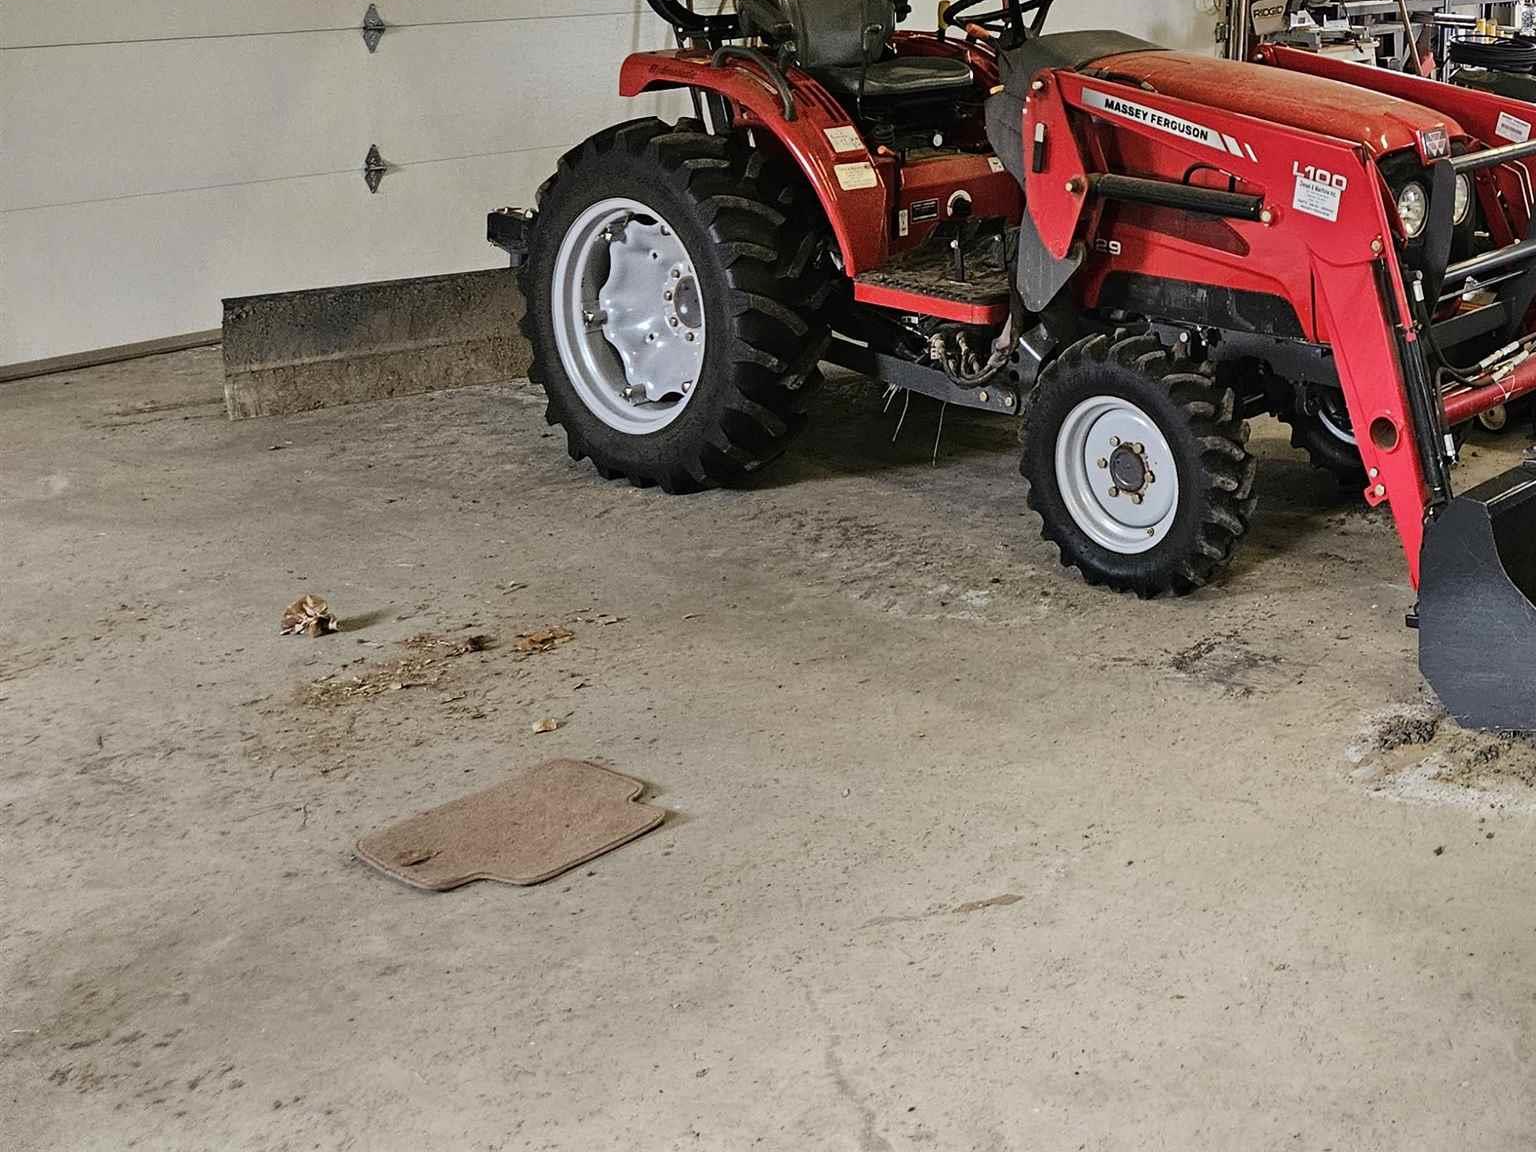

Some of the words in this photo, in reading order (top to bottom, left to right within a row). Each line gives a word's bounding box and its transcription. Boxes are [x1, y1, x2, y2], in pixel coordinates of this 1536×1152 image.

[1104, 98, 1149, 121] MASSEY
[1150, 114, 1209, 141] FERGUSON
[1292, 160, 1348, 192] L100
